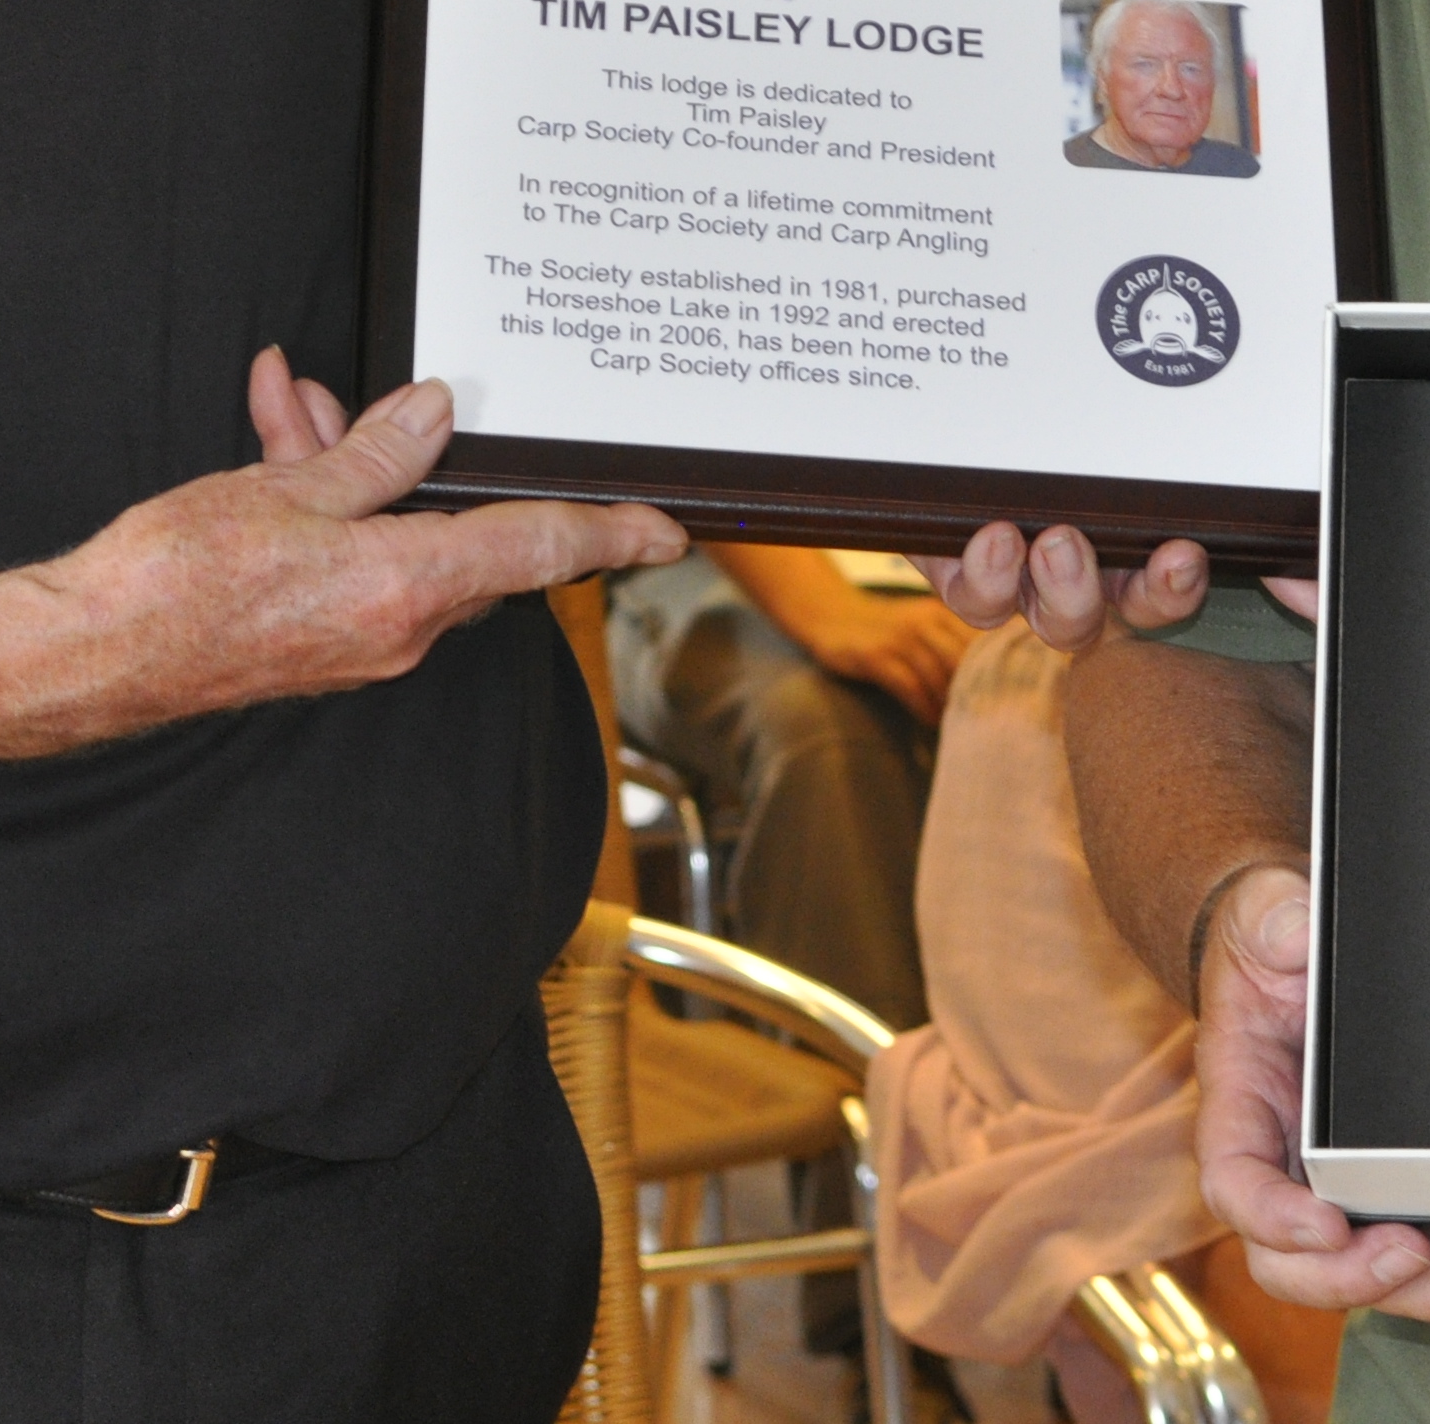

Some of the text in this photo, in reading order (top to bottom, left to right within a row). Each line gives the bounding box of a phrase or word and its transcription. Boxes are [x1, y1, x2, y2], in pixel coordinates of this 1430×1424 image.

[623, 2, 812, 46] PAISLEY
[826, 17, 984, 59] LODGE
[601, 68, 913, 110] This lodge is dedicated to
[517, 115, 996, 169] Carp Society Co-founder and President
[686, 102, 827, 136] Tim Paisley
[519, 173, 993, 226] In recognition of a lifetime commitment
[522, 202, 989, 258] to The Carp Society and Carp Angling
[484, 254, 1026, 312] The Society established in 1981, purchased
[1109, 268, 1228, 343] The CARP SOCIETY
[526, 286, 985, 338] Horseshoe Lake in 1992 and erected
[500, 313, 1009, 368] this lodge in 2006, has been home to the
[590, 347, 920, 390] Carp Society offices since.
[1144, 359, 1196, 376] Est 1981
